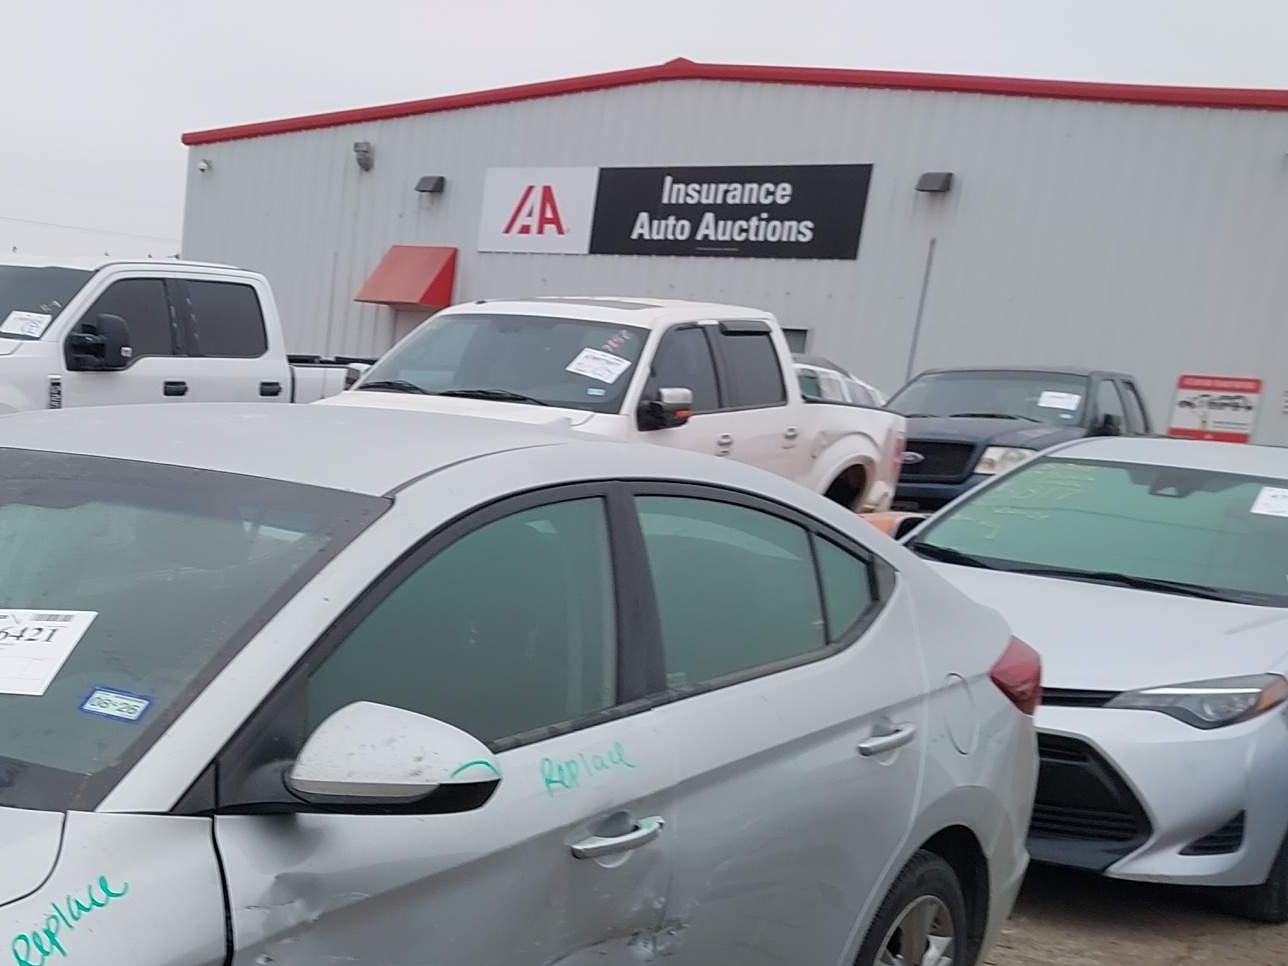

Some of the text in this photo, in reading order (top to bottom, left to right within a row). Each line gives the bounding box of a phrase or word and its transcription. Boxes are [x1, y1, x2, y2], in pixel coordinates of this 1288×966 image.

[662, 175, 793, 205] Insurance
[630, 212, 815, 242] Auto Auctions
